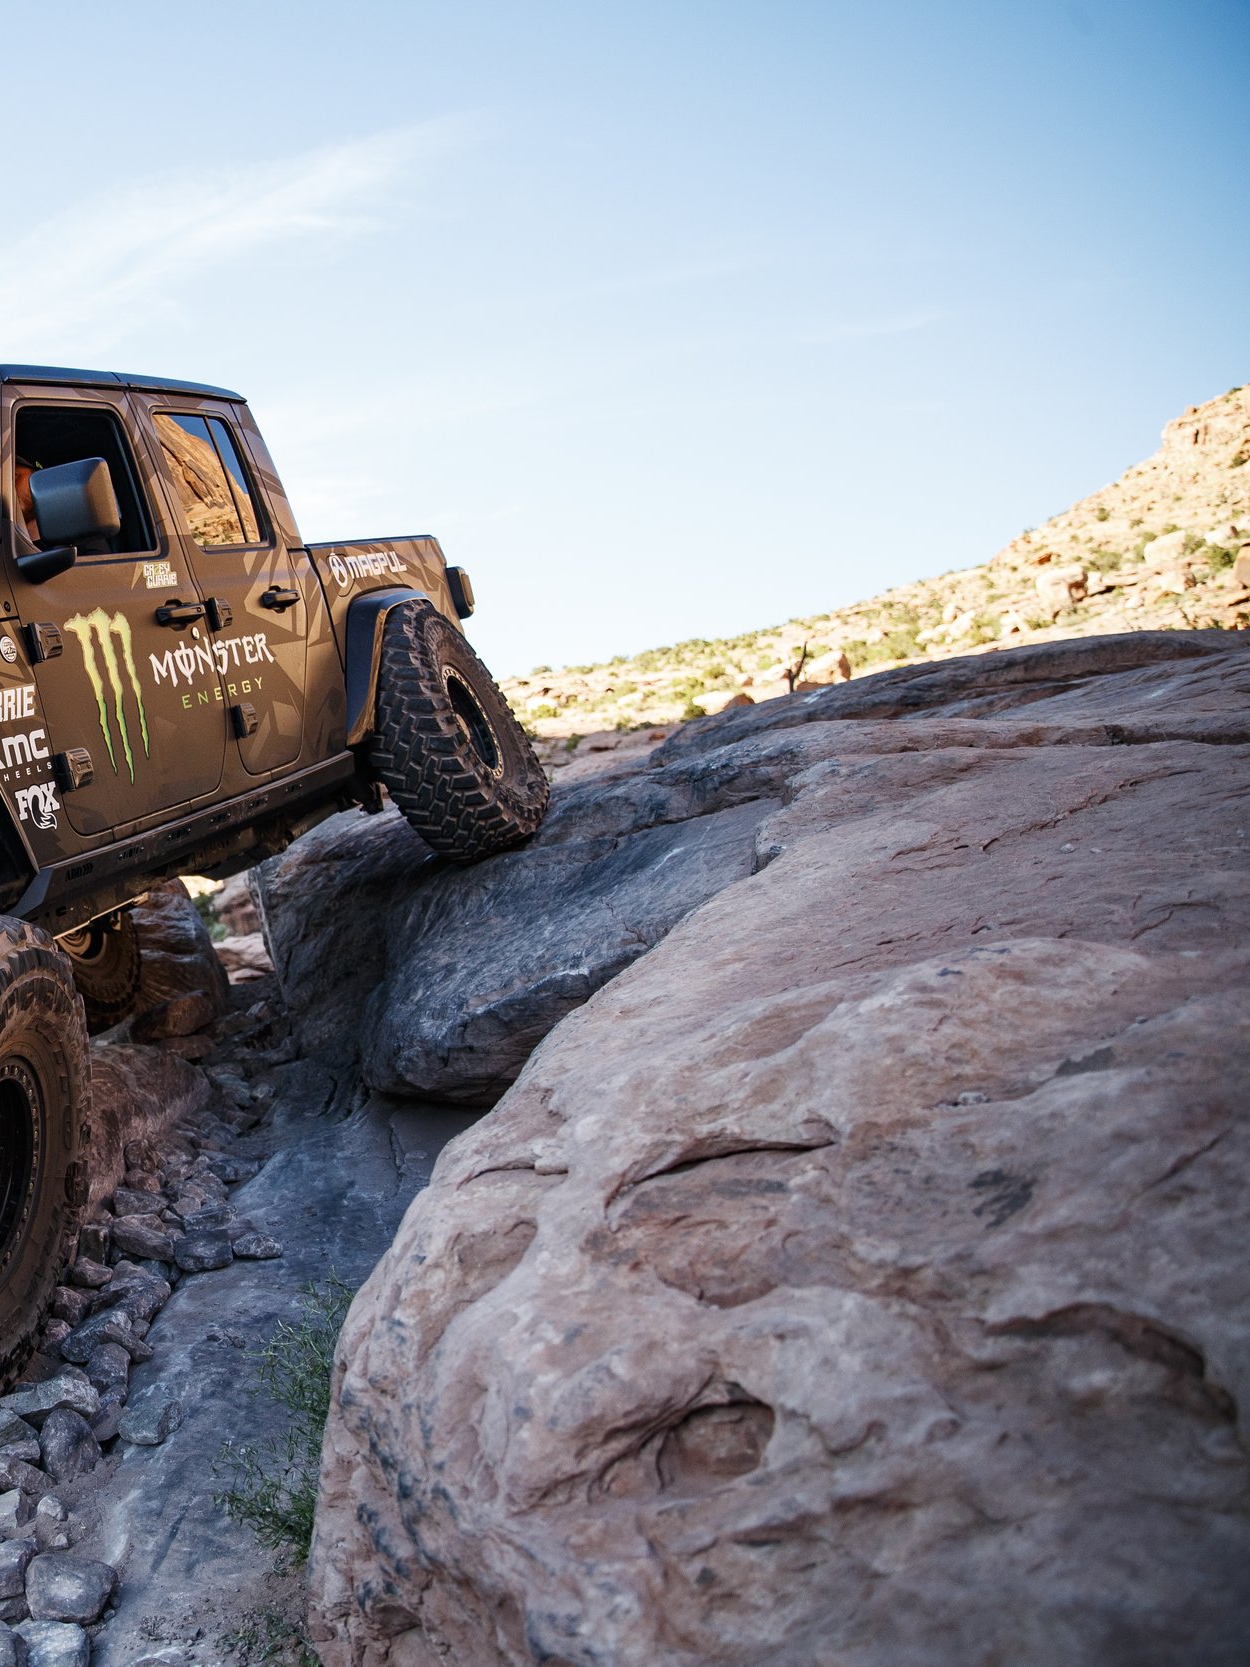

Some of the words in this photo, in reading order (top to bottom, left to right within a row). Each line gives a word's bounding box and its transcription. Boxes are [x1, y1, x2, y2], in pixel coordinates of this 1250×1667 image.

[344, 551, 407, 579] MAGPUL
[148, 632, 275, 687] MONSTER
[182, 677, 263, 709] ENERGY
[3, 762, 53, 782] HEELS
[15, 781, 60, 829] FOX
